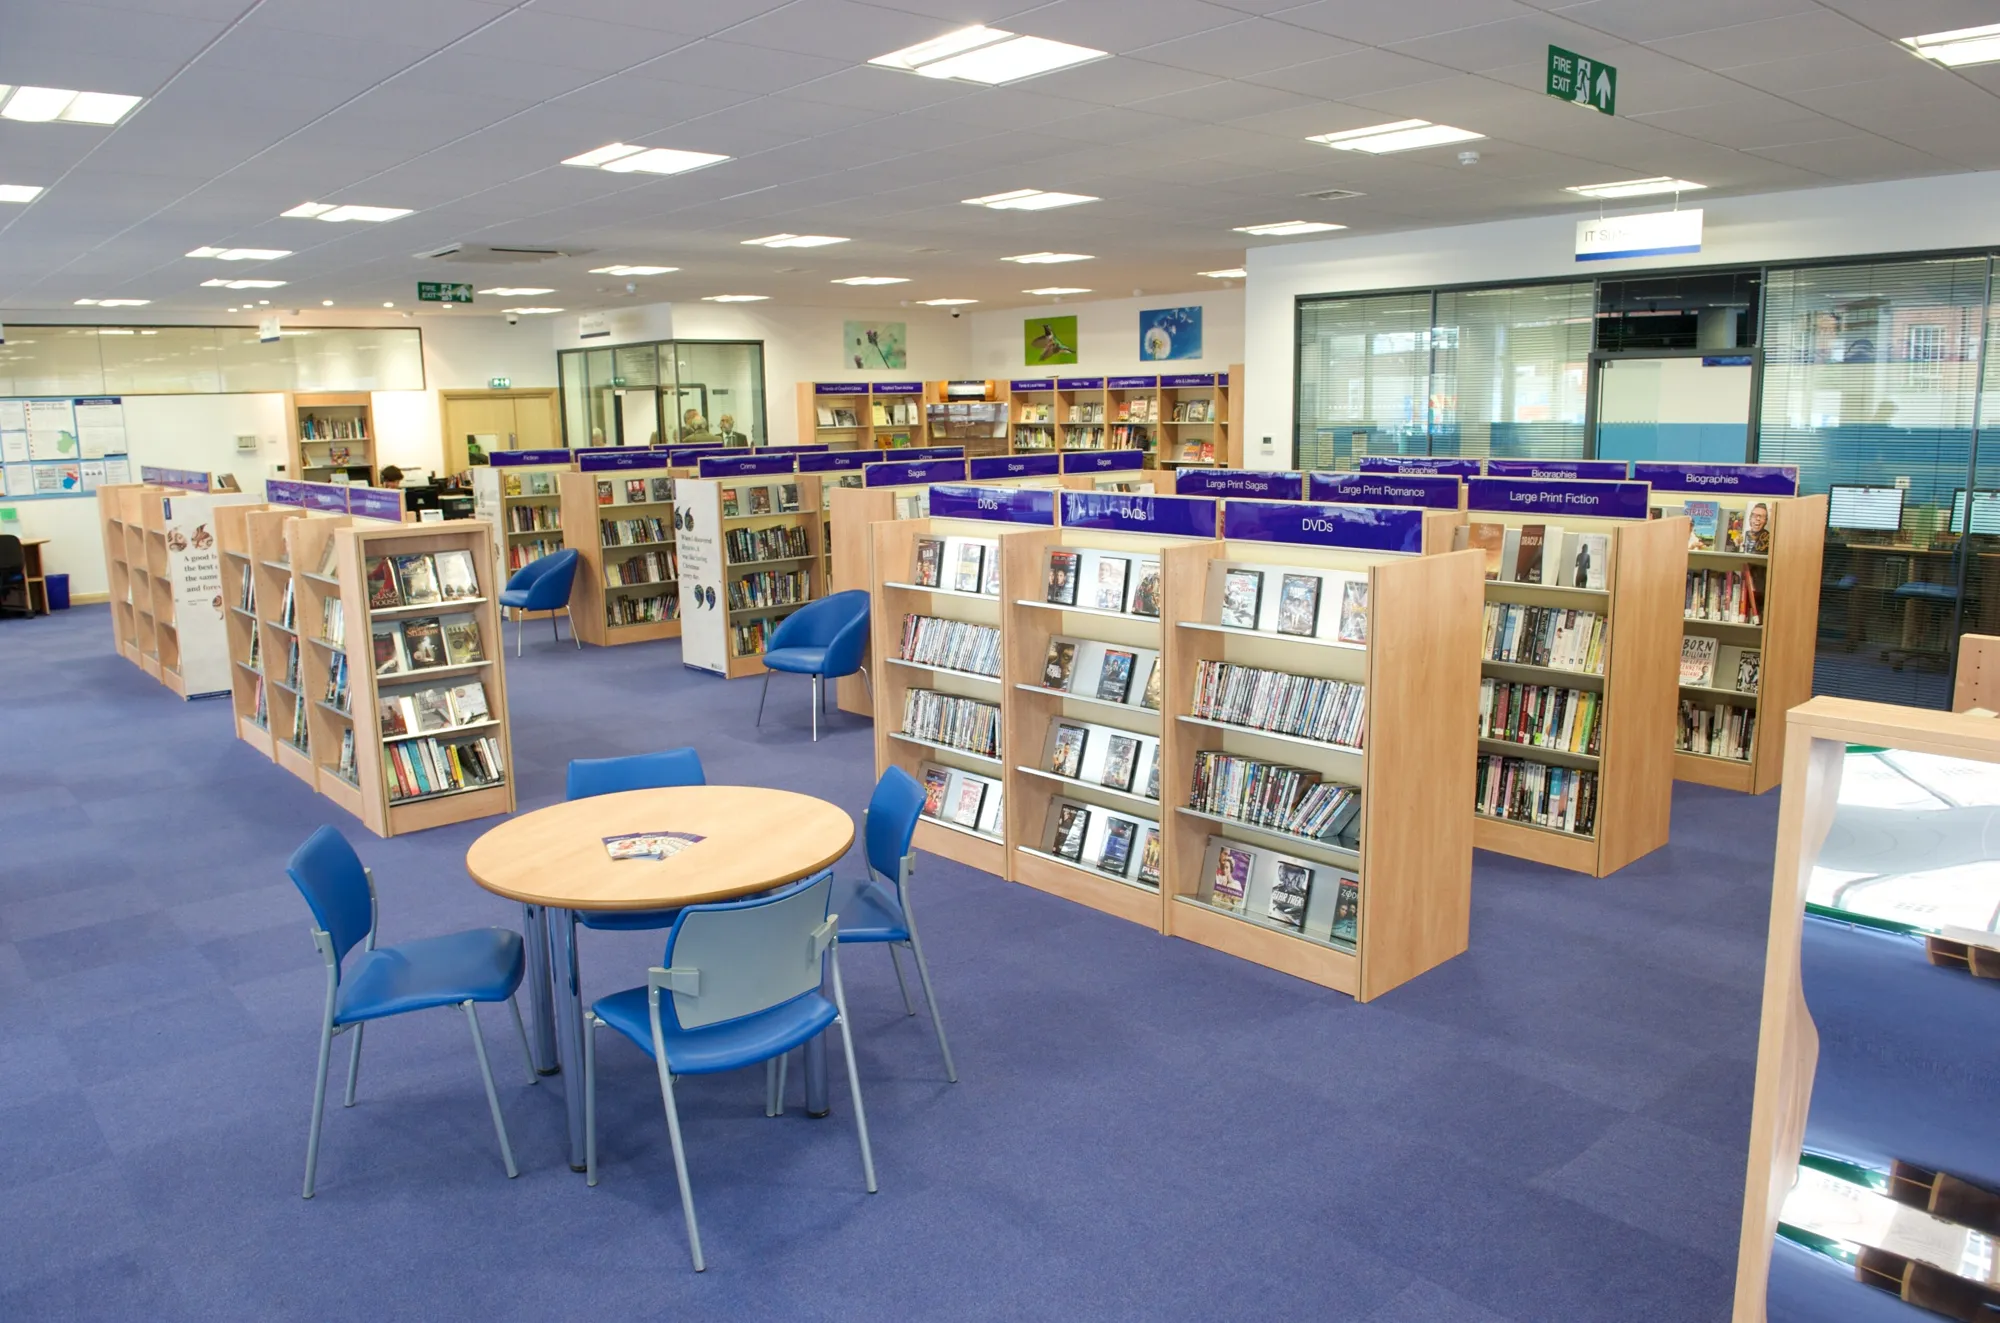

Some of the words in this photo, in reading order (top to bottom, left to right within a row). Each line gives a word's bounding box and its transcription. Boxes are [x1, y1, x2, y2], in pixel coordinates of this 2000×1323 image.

[1553, 55, 1572, 74] FIRE
[1552, 74, 1571, 93] EXIT
[1584, 230, 1595, 242] IT
[1008, 463, 1024, 472] Sagas
[1097, 458, 1111, 466] Sagas
[908, 469, 926, 478] Sagas
[1398, 466, 1438, 474] Biographies
[1531, 469, 1577, 479] Biographies
[1686, 473, 1738, 485] Biographies
[1206, 480, 1226, 490] Large
[1227, 480, 1244, 489] Print
[1245, 480, 1268, 491] Sagas
[1338, 485, 1360, 496] Large
[1362, 486, 1382, 495] Print
[1384, 486, 1425, 497] Romance
[1510, 491, 1537, 502] Large
[1540, 492, 1562, 502] Print
[1565, 493, 1599, 504] Fiction
[978, 499, 998, 510] DVDs
[1122, 508, 1146, 520] DVDs
[1302, 518, 1333, 532] DVDs
[191, 554, 209, 562] good
[1684, 639, 1714, 652] BORN
[1682, 650, 1711, 659] BRILLIANT
[1272, 890, 1288, 902] STAR
[1289, 894, 1305, 906] TREK
